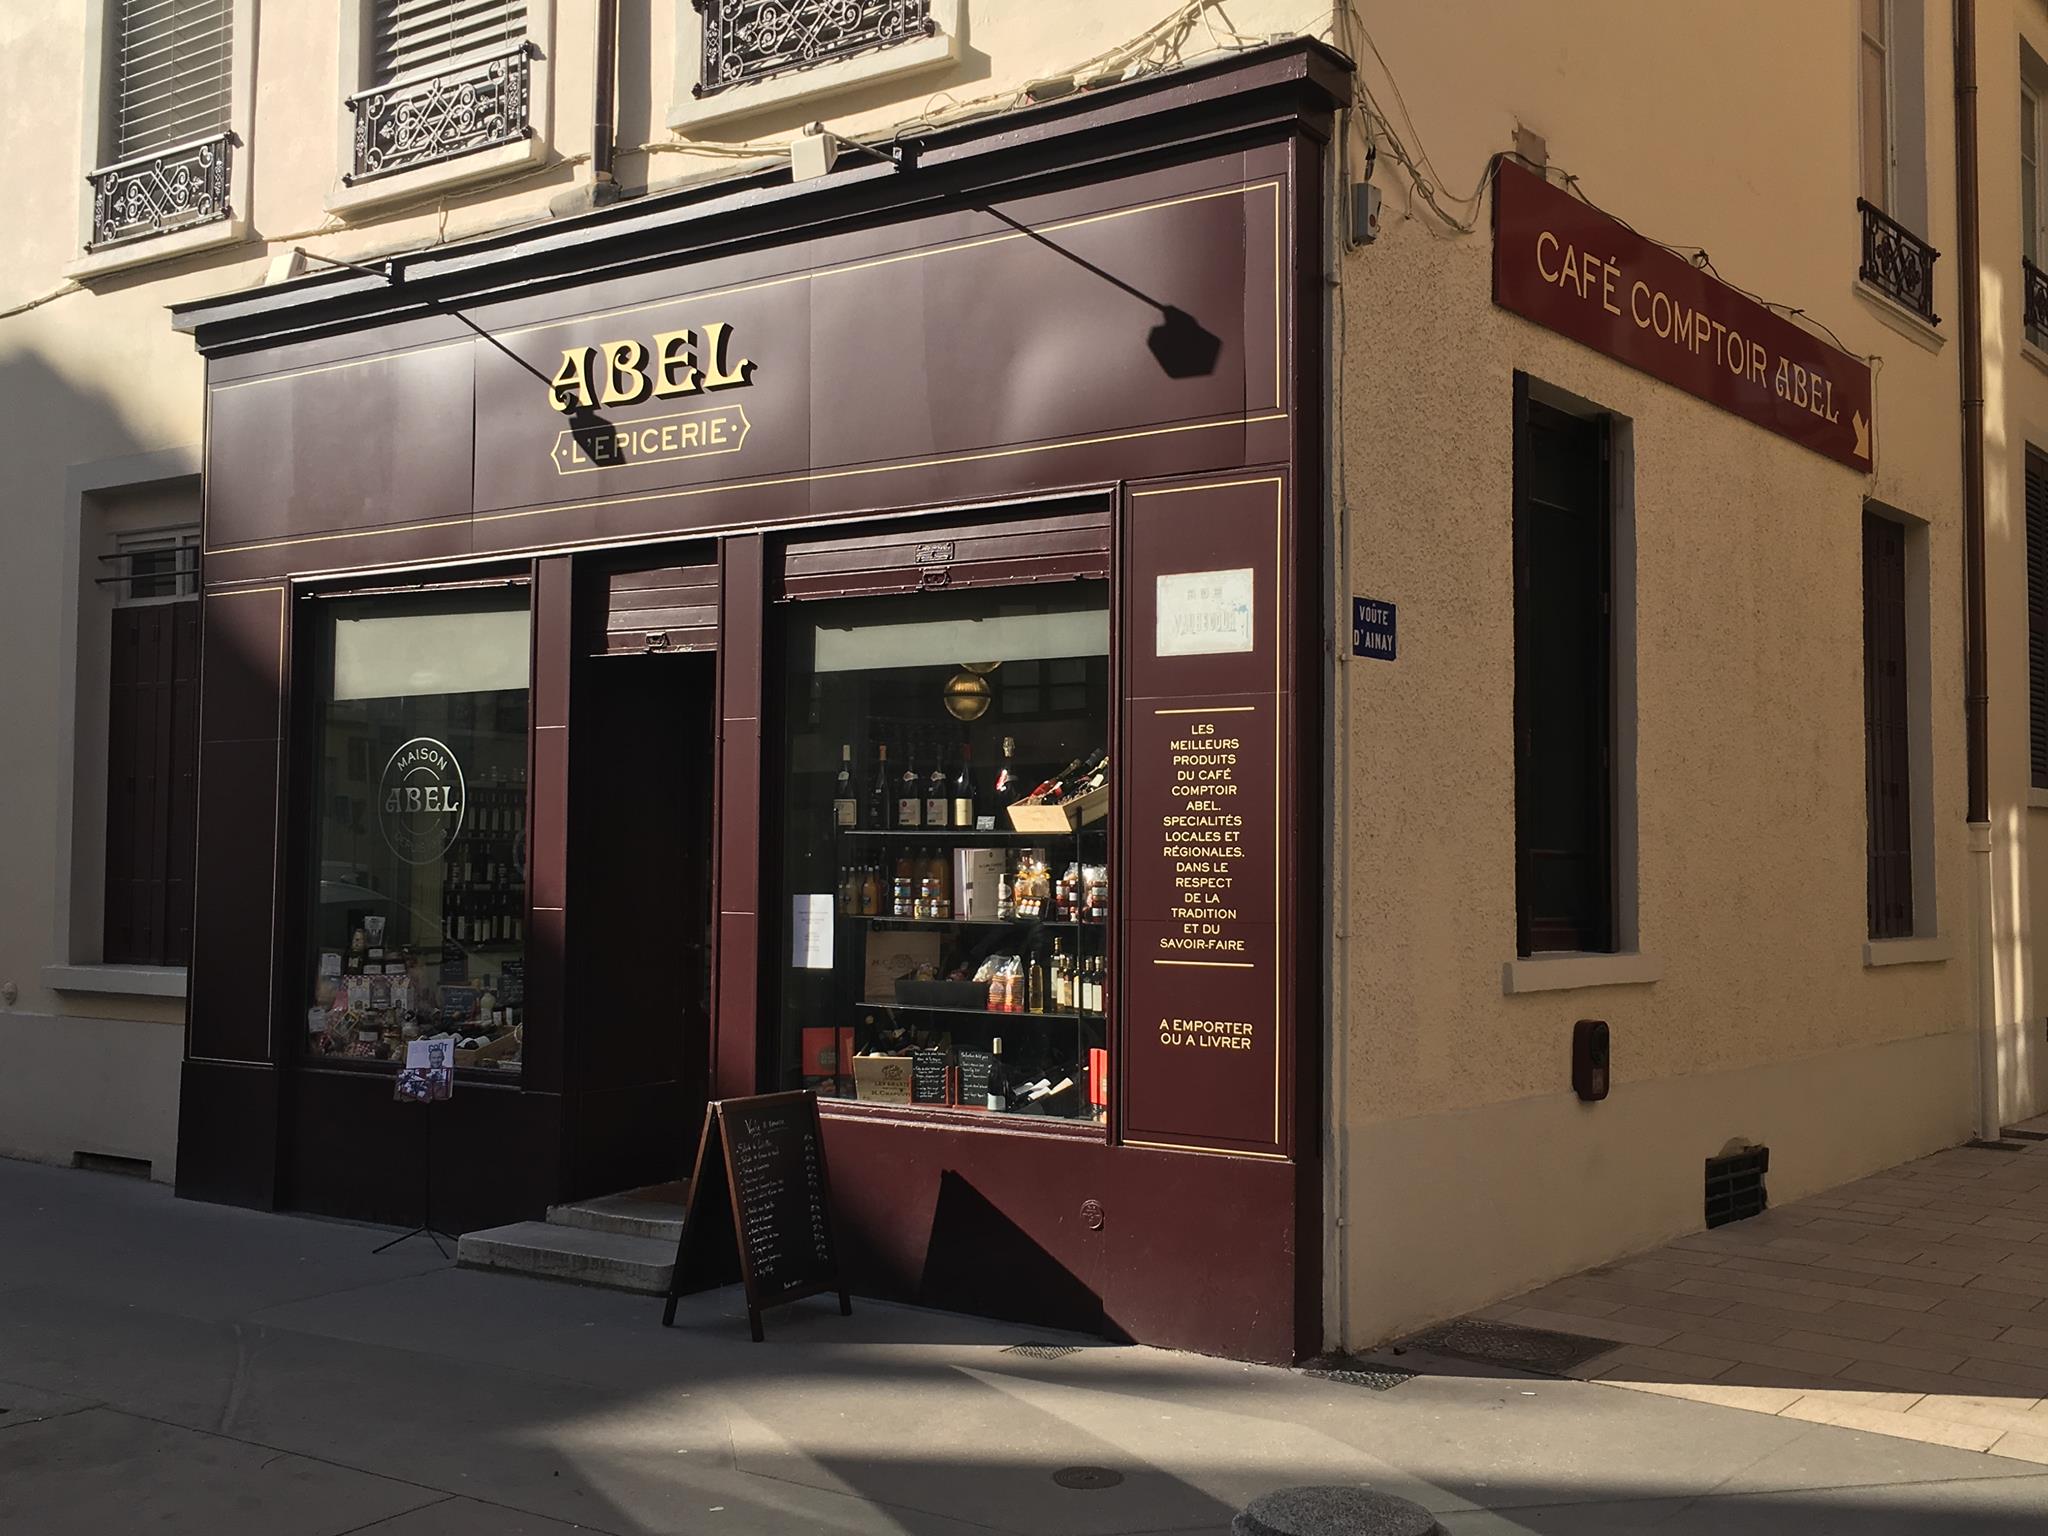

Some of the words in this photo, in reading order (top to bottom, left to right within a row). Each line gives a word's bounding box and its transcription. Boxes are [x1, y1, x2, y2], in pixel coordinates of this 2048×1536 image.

[1536, 231, 1621, 316] CAFÉ
[1631, 281, 1768, 388] COMPTOIR
[1776, 356, 1839, 424] ABEL
[548, 322, 758, 414] ABEL
[572, 418, 727, 464] L'EPICERIE
[1359, 603, 1389, 625] VOÛTE
[1354, 629, 1392, 651] D'AINAY
[1192, 724, 1214, 734] LES
[1171, 739, 1239, 750] MEILLEURS
[397, 748, 447, 772] MAISON
[1174, 754, 1236, 765] PRODUITS
[1178, 771, 1194, 780] DU
[1199, 768, 1231, 780] CAFÉ
[1172, 785, 1237, 796] COMPTOIR
[385, 786, 459, 813] ABEL
[1166, 832, 1221, 841] LOCALES
[1225, 832, 1239, 841] ET
[1164, 845, 1244, 857] RÉGIONALES.
[1177, 862, 1210, 872] DANS
[1214, 863, 1228, 872] LE
[1176, 878, 1232, 888] RESPECT
[1185, 893, 1201, 903] DE
[1205, 894, 1220, 903] LA
[1171, 908, 1236, 919] TRADITION
[1184, 924, 1199, 933] ET
[1203, 924, 1219, 934] DU
[1160, 938, 1244, 950] SAVOIR-FAIRE
[1160, 1019, 1169, 1030] A
[1173, 1020, 1253, 1035] EMPORTER
[1161, 1033, 1181, 1045] OU
[1186, 1035, 1195, 1046] A
[1199, 1036, 1252, 1049] LIVRER
